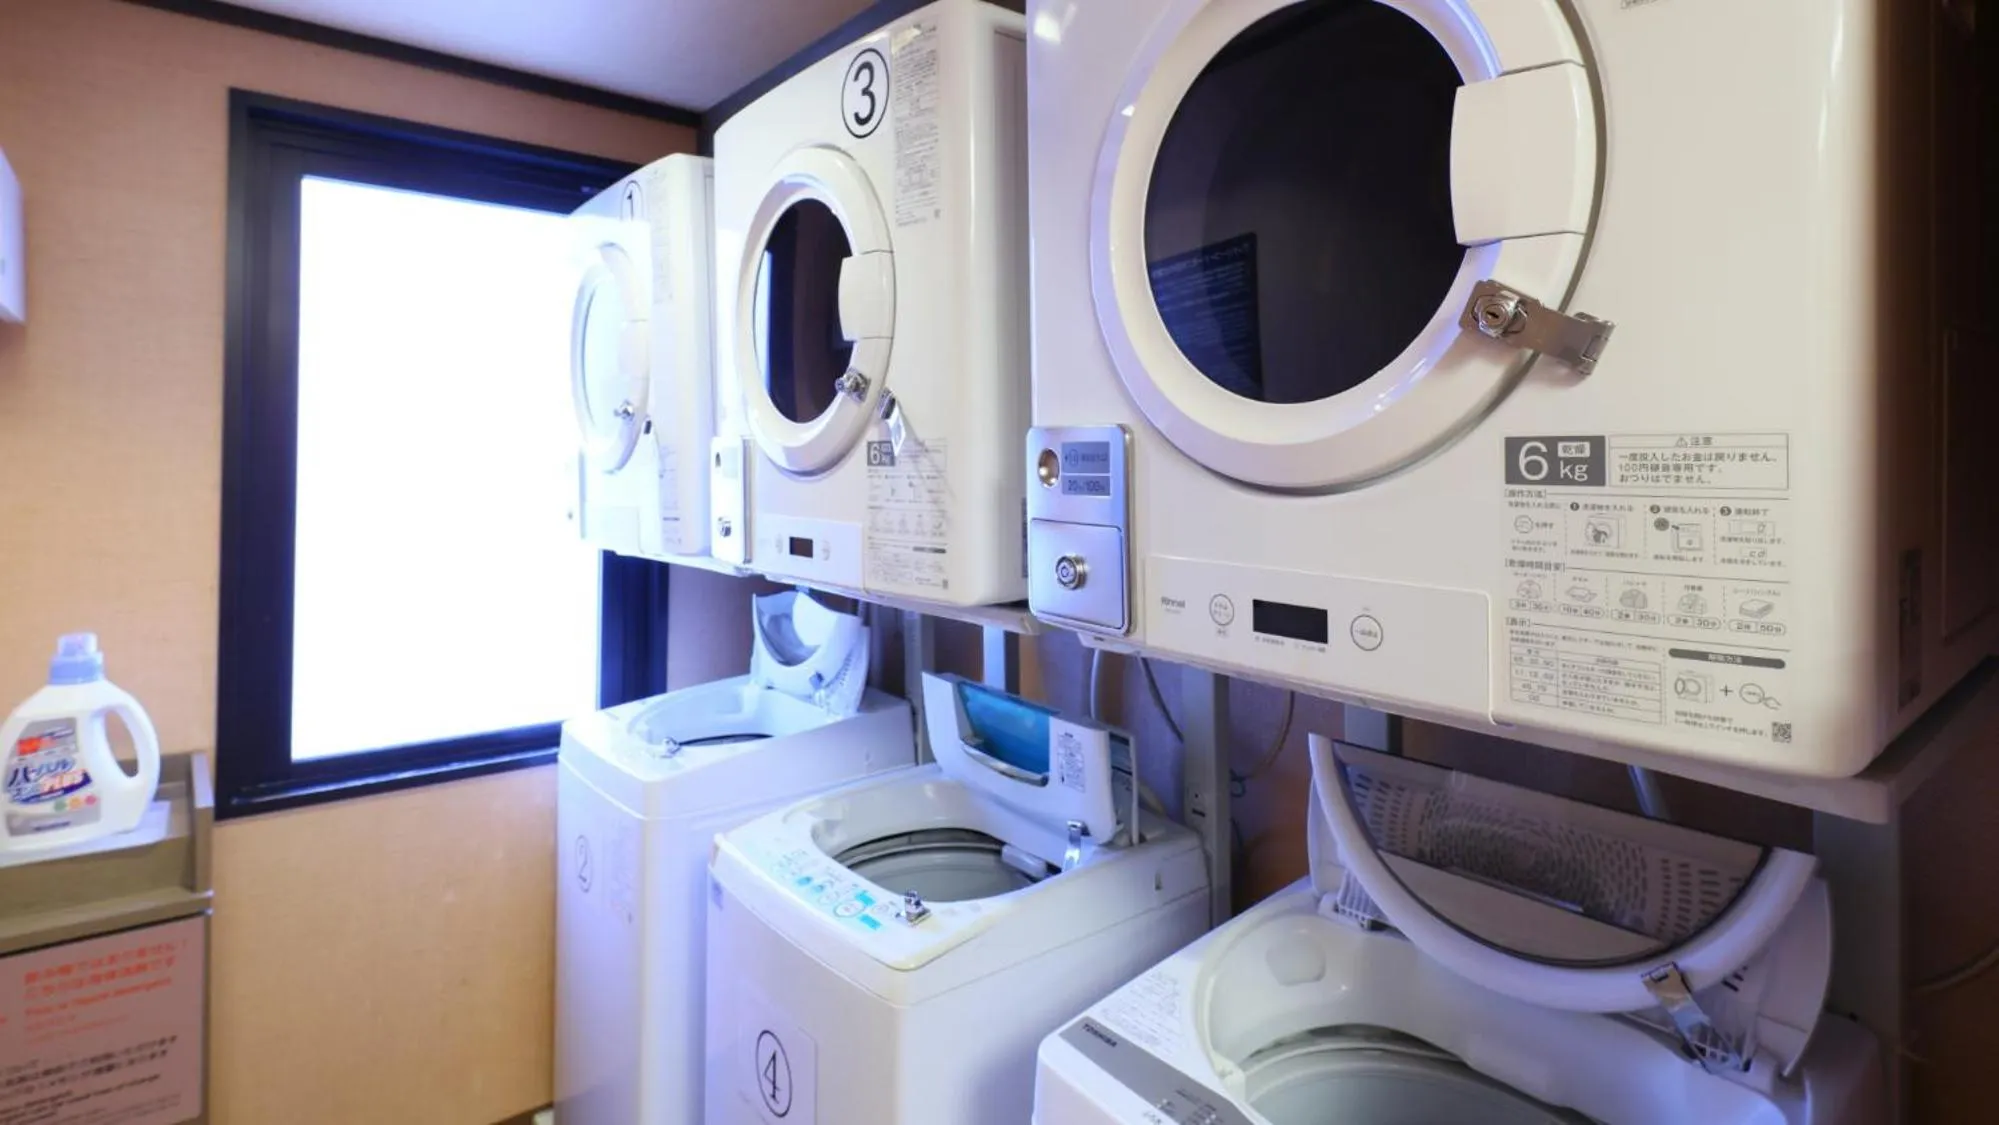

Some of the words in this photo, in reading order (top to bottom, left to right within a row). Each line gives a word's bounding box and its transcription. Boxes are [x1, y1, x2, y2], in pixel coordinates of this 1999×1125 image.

[870, 443, 880, 465] 6
[1518, 440, 1549, 481] 6
[1560, 460, 1589, 482] kg
